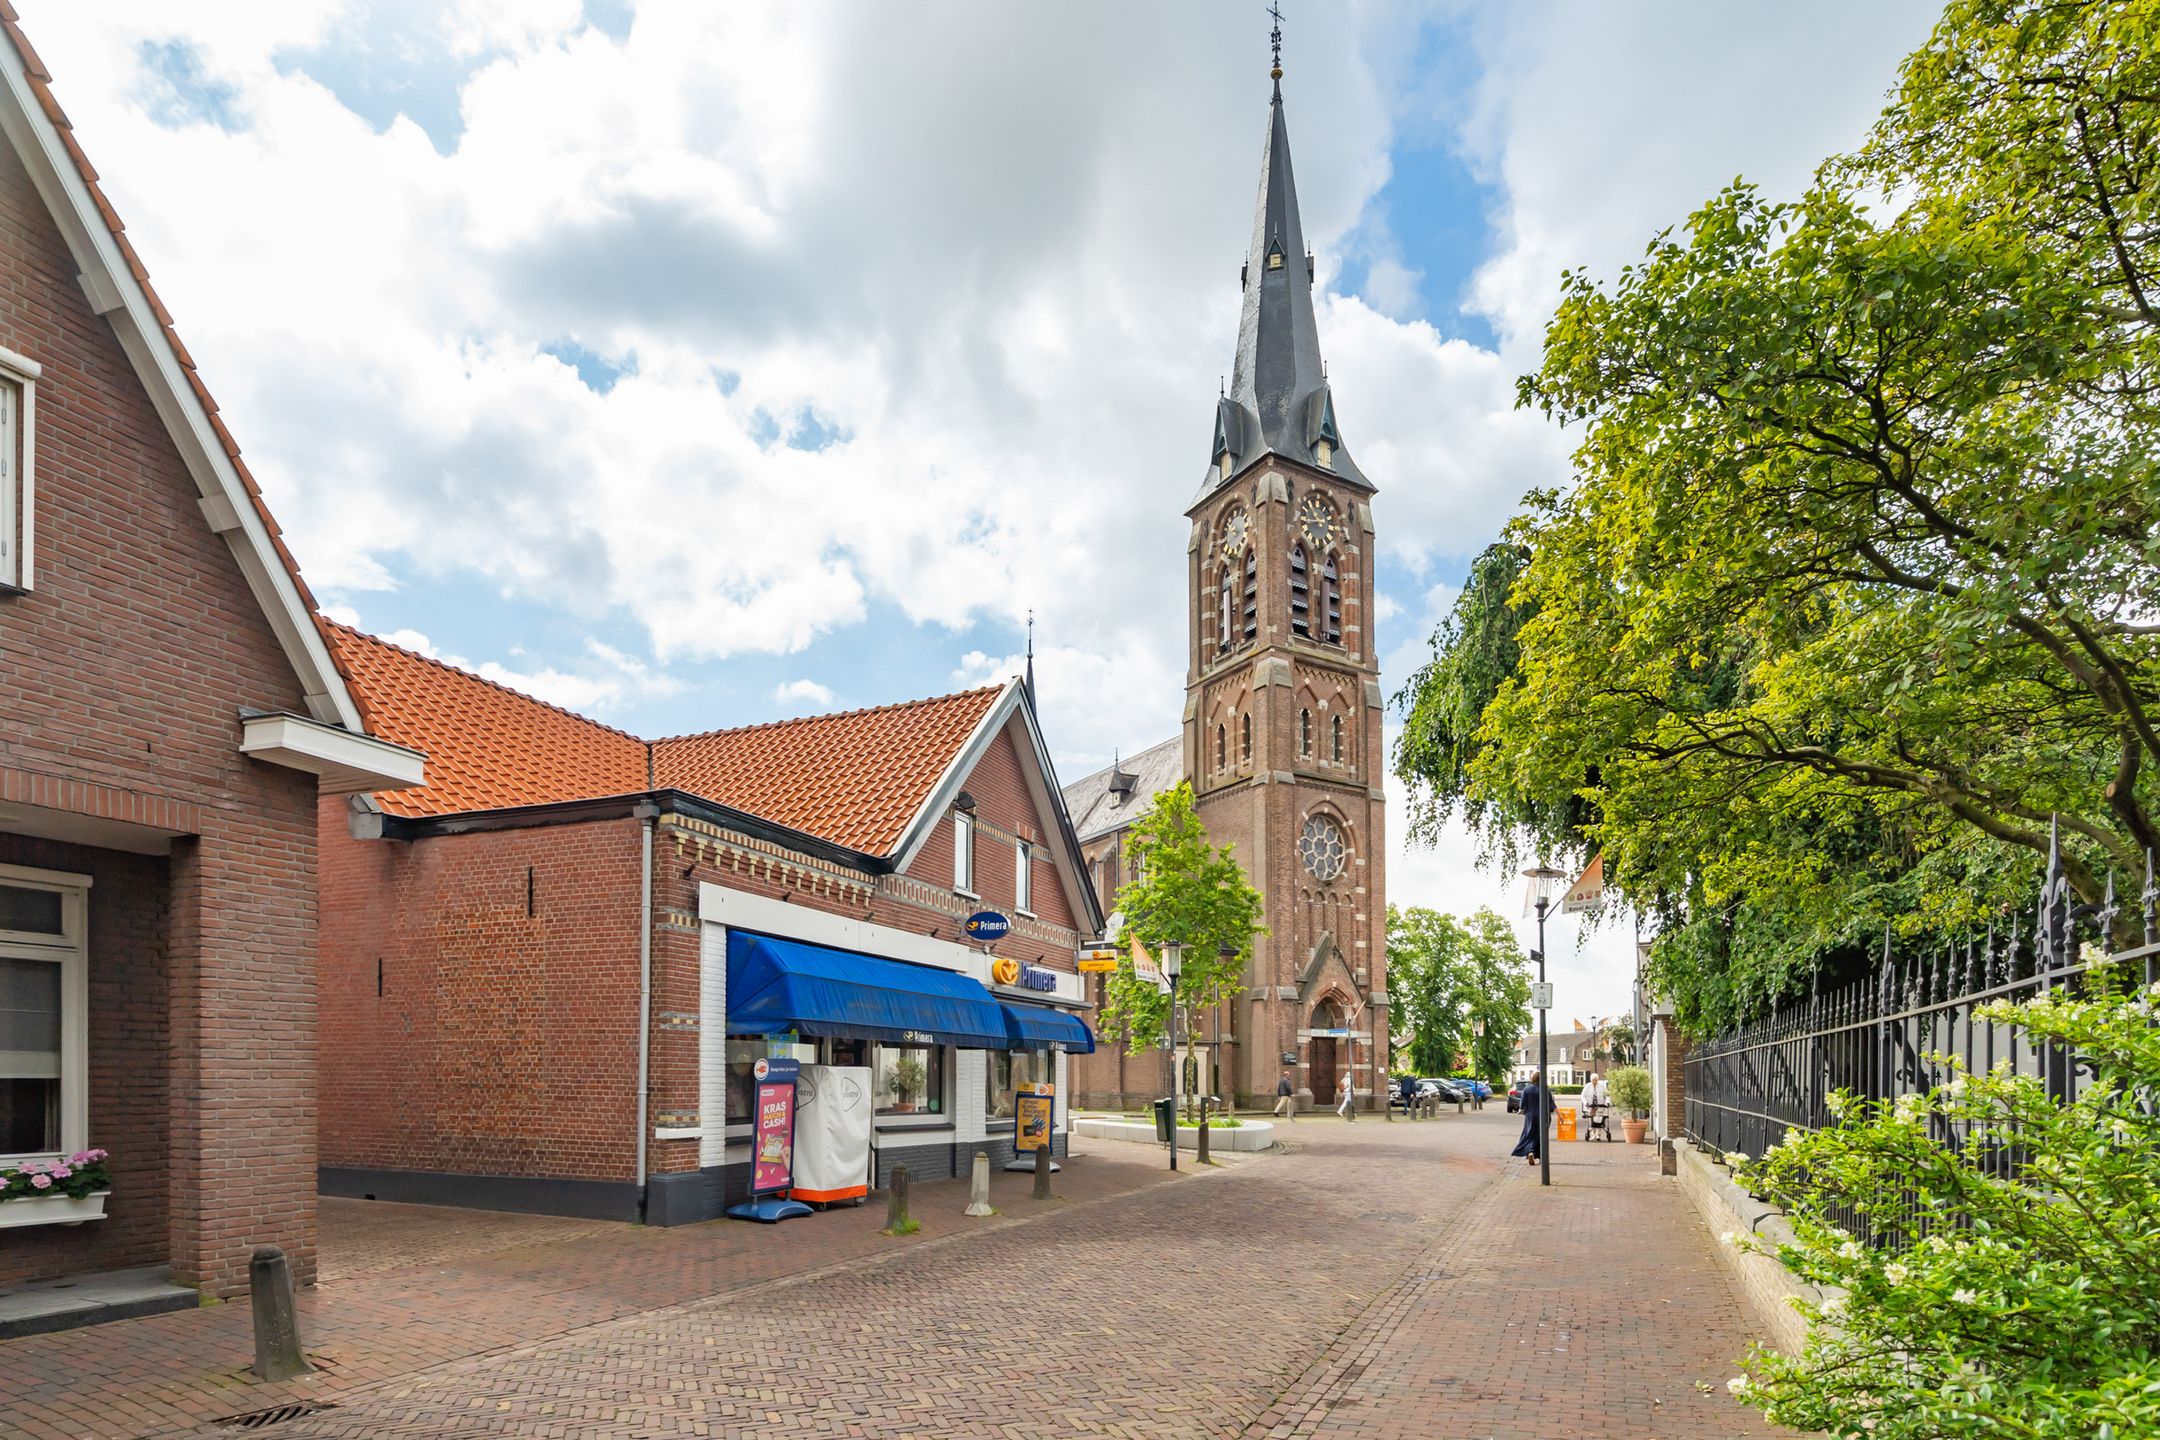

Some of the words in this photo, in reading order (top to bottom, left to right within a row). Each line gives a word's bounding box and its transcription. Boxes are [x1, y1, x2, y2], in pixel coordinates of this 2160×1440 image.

[980, 921, 1007, 931] Primera
[1022, 961, 1056, 992] Primera
[763, 1101, 787, 1115] KRAS
[763, 1116, 786, 1129] CASH!
